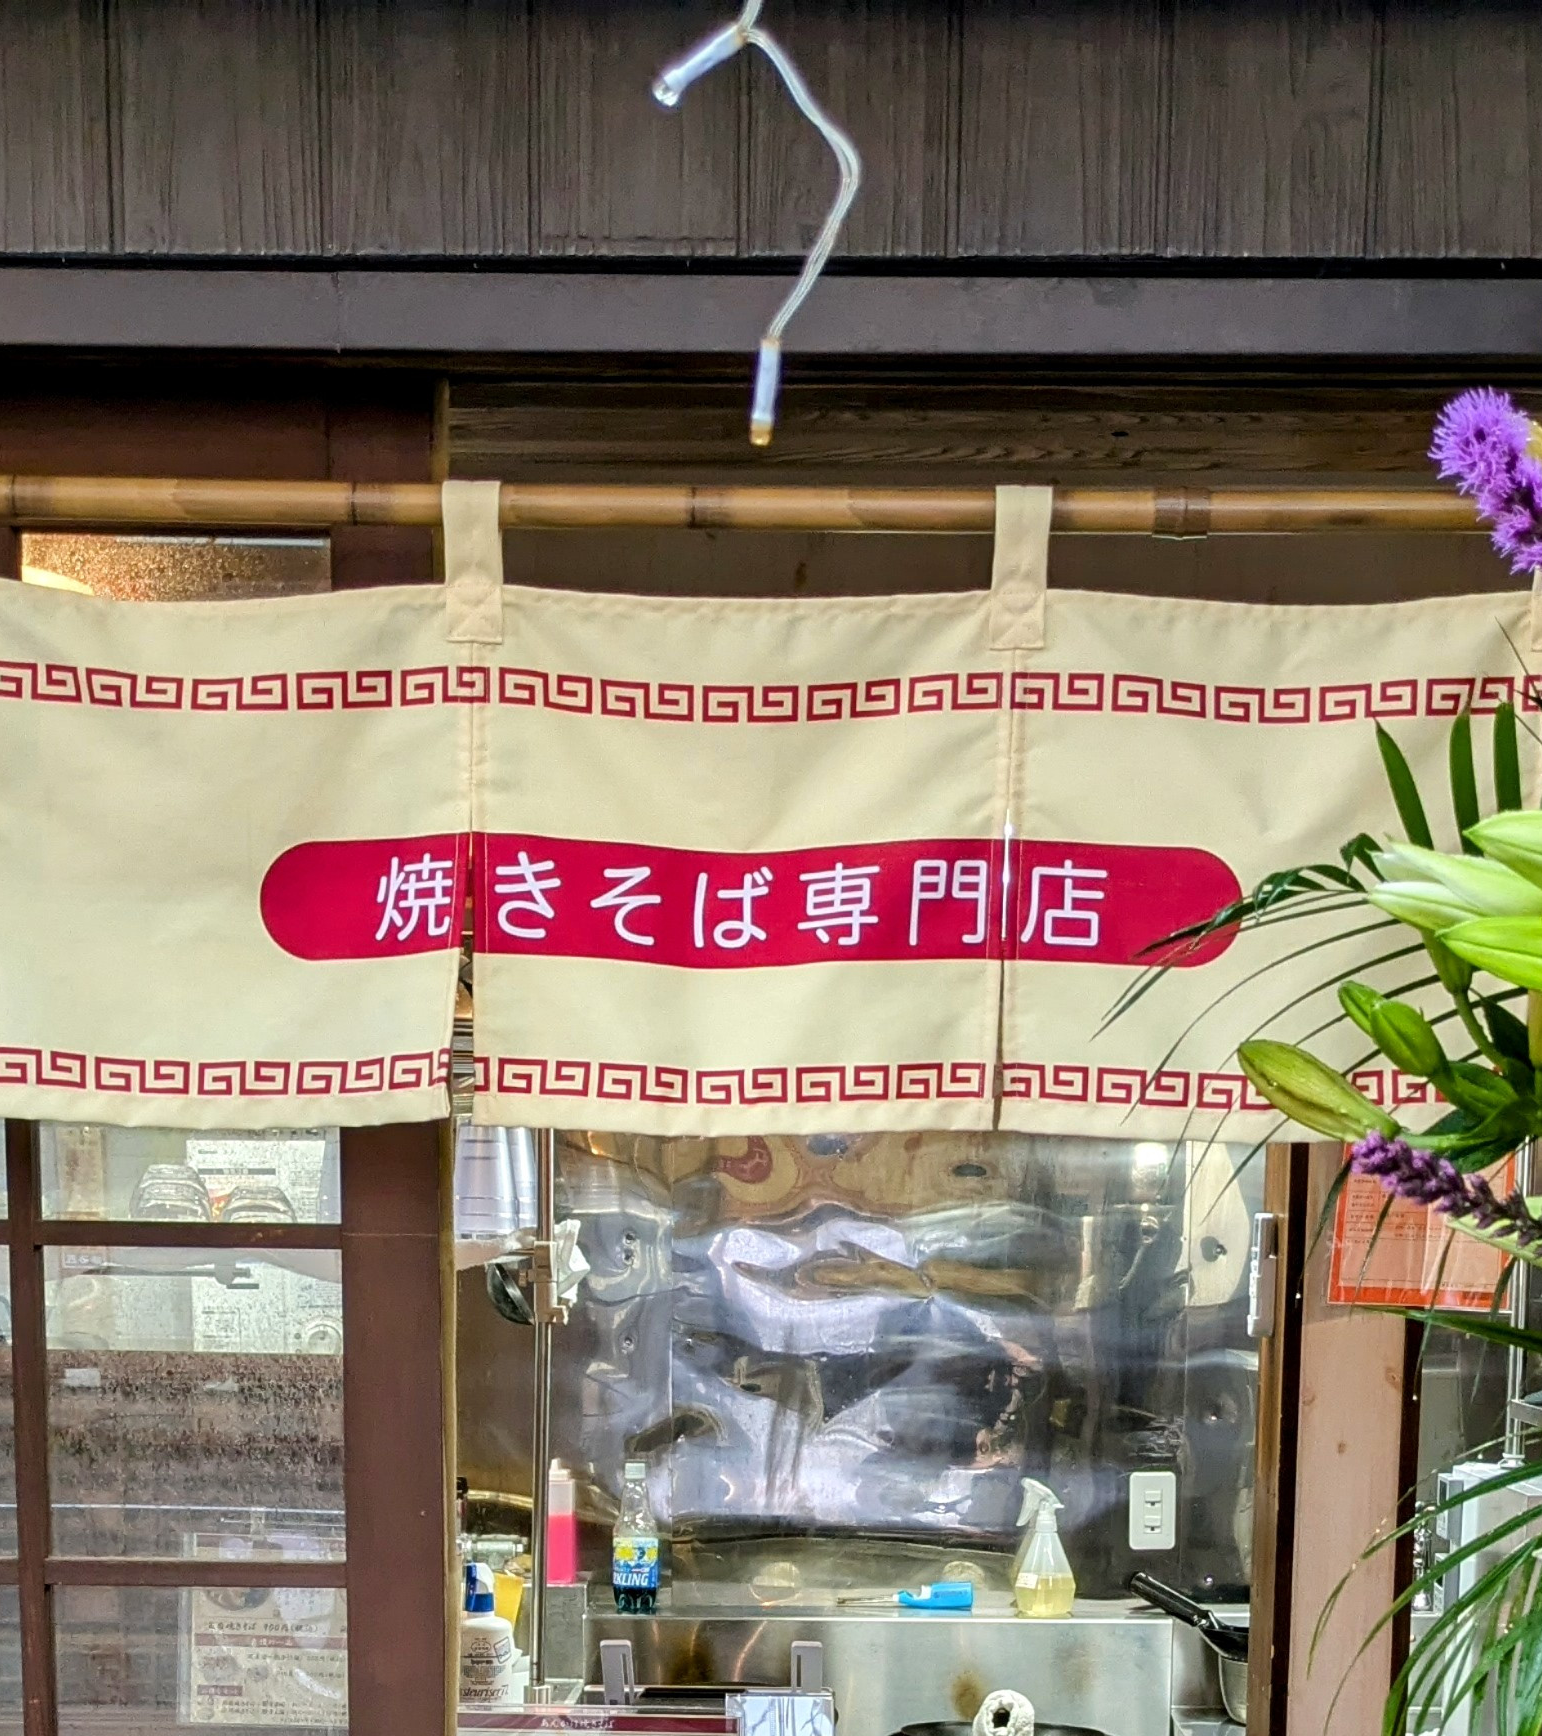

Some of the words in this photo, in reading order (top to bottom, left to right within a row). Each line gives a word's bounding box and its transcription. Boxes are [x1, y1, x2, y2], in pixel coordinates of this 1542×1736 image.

[374, 850, 1109, 949] 焼きそば専門店
